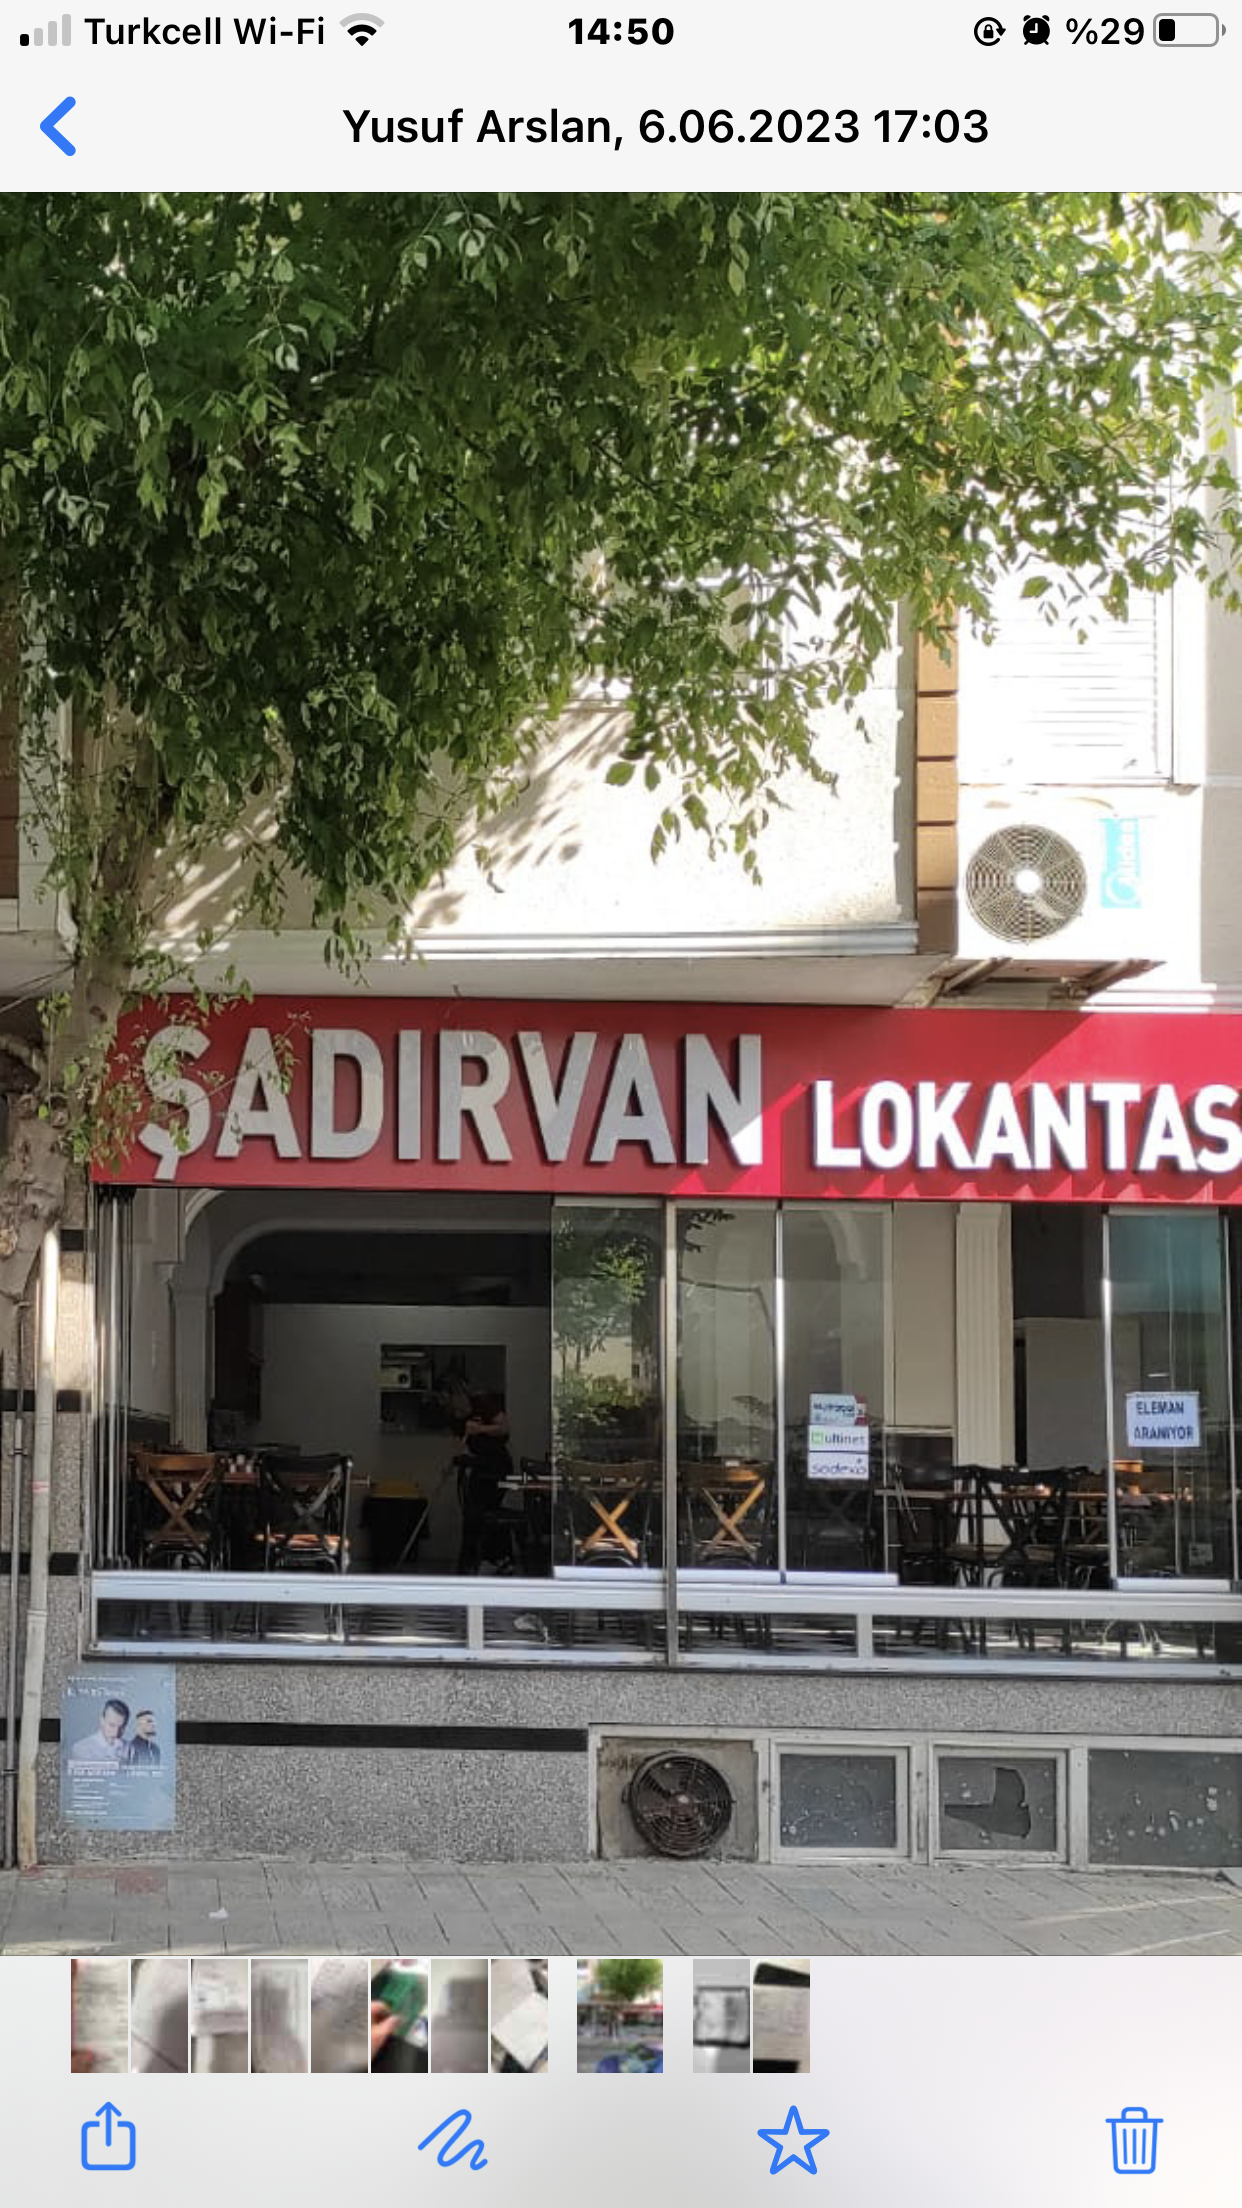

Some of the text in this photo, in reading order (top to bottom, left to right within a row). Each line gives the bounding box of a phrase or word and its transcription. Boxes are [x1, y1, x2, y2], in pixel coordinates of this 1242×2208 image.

[138, 1024, 763, 1181] ŞADIRVAN
[813, 1080, 1242, 1172] LOKANTAS
[1134, 1426, 1194, 1440] ARANIYOR
[1136, 1401, 1184, 1414] ELEMAN
